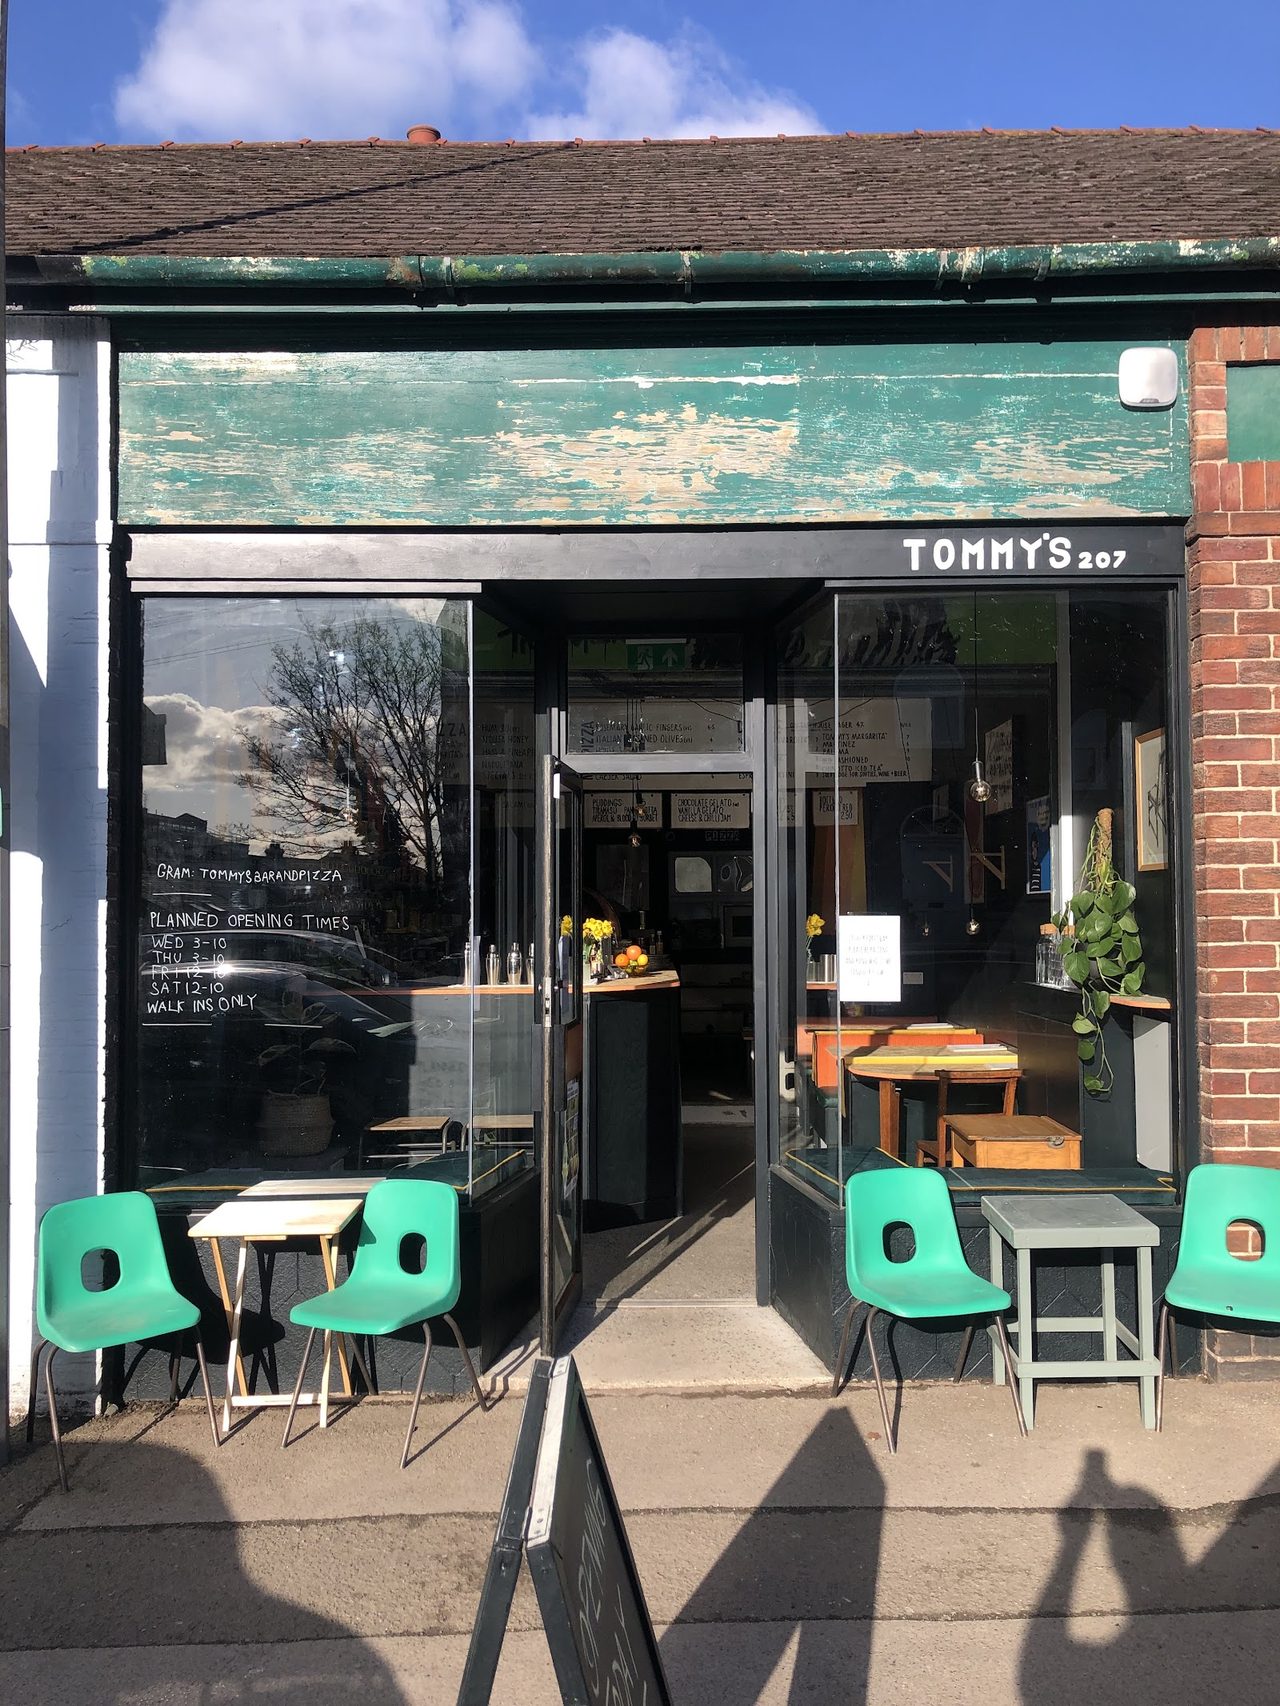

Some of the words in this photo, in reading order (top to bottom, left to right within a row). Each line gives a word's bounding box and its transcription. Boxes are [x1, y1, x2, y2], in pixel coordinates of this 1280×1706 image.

[903, 533, 1072, 571] TOMMY'S
[1078, 550, 1127, 569] 207
[838, 756, 869, 764] ASHIONED
[157, 863, 195, 880] GRAM:
[150, 911, 219, 928] PLANNED
[227, 913, 293, 929] OPENING
[302, 914, 350, 931] TIMES
[151, 934, 184, 949] WED
[193, 937, 227, 950] 3-10
[152, 950, 182, 964] THU
[192, 952, 225, 966] 3-10
[151, 965, 178, 980] FRI
[187, 966, 226, 979] 1210
[150, 981, 181, 996] SAT
[186, 981, 224, 996] 12-10
[147, 1000, 185, 1014] WALK
[193, 998, 214, 1013] INS
[218, 993, 257, 1011] ONLY
